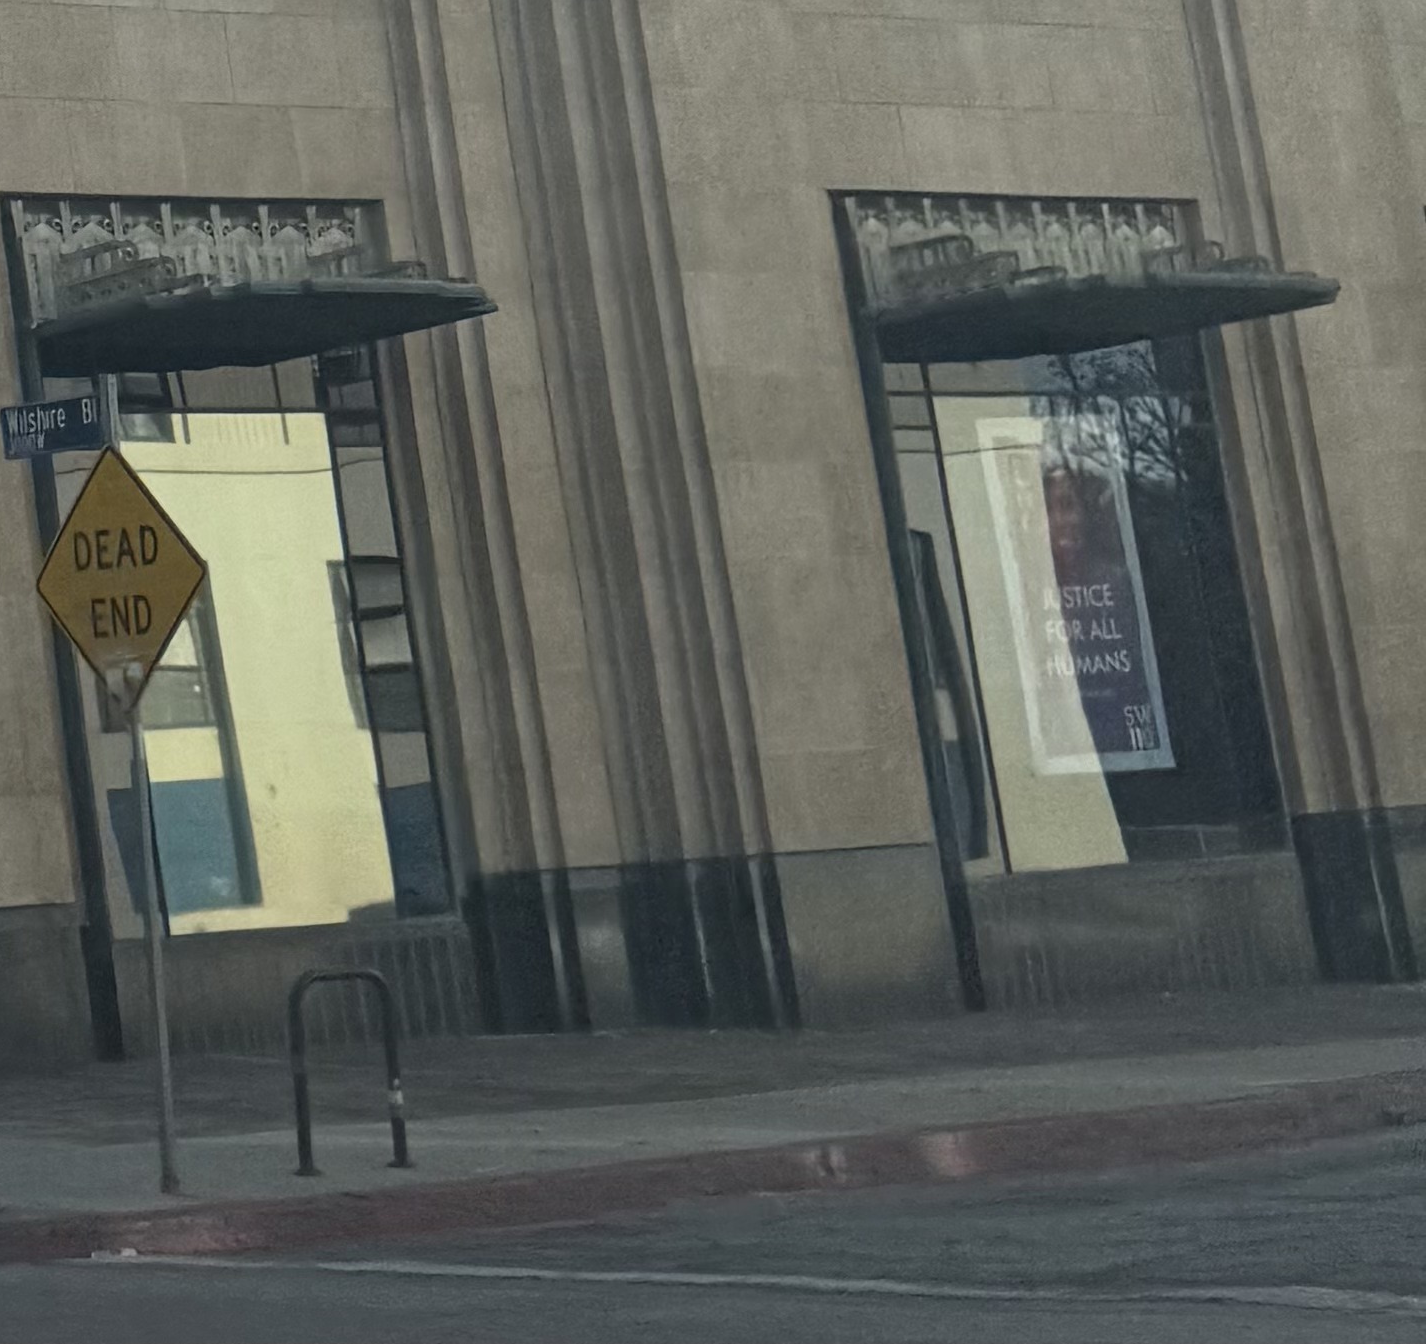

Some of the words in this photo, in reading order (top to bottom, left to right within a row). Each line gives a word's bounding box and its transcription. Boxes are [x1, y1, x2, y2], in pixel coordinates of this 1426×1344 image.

[6, 406, 65, 433] Wilshire
[73, 524, 158, 571] DEAD
[1043, 583, 1114, 610] JUSTICE
[90, 594, 151, 639] END
[1045, 619, 1084, 643] FOR
[1090, 617, 1122, 641] ALL
[1047, 649, 1131, 677] HUMANS
